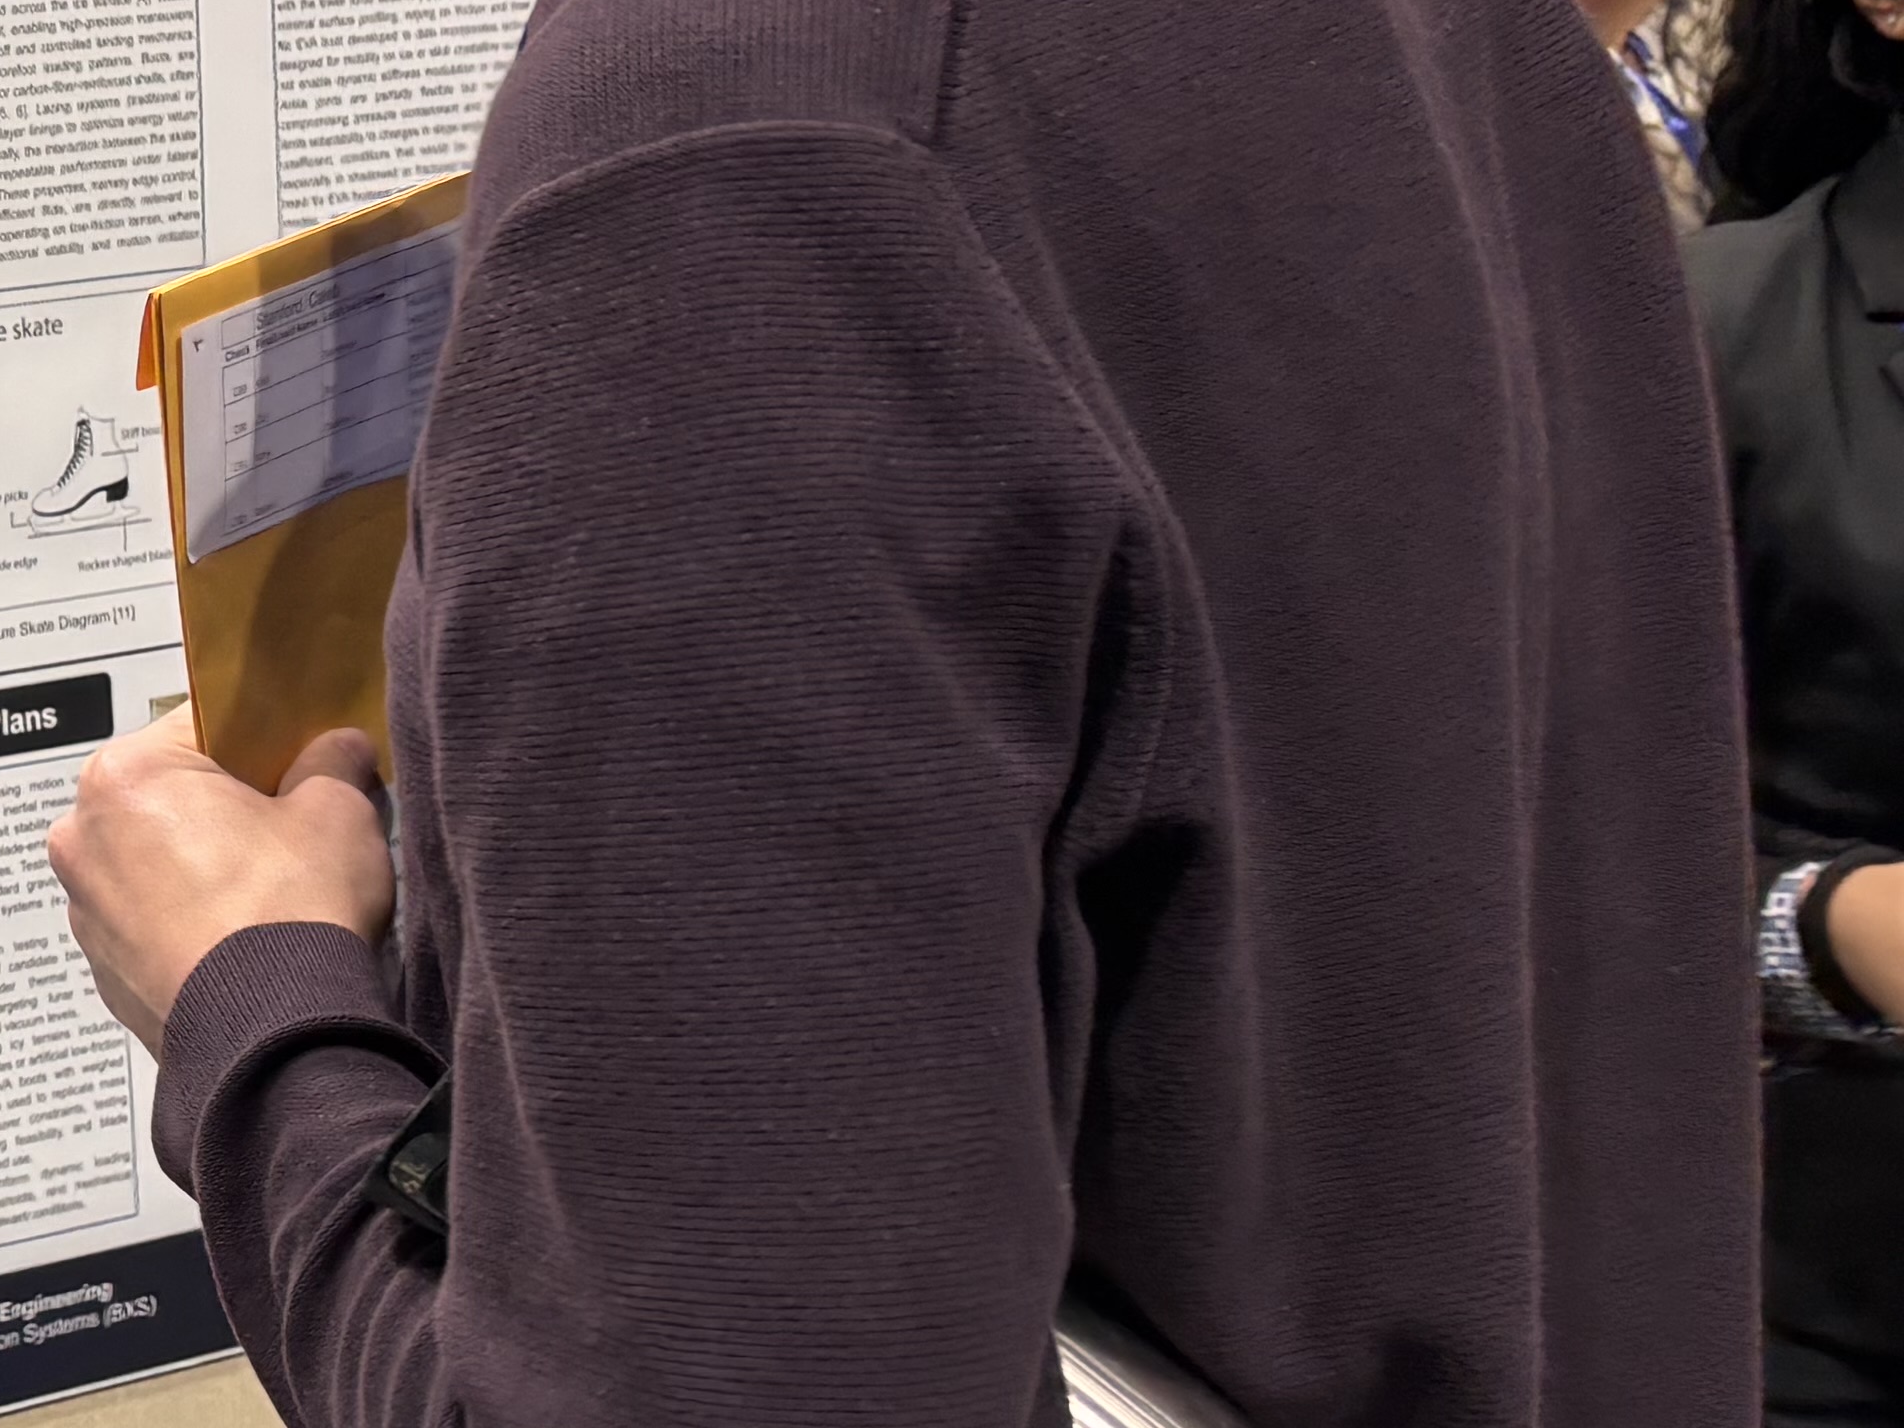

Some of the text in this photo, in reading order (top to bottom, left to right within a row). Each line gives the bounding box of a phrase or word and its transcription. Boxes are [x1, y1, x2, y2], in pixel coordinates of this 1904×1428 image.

[14, 316, 64, 341] skate
[20, 620, 54, 638] Skate
[59, 610, 110, 633] Diagram
[113, 605, 136, 624] [11]
[23, 1310, 99, 1347] Systems
